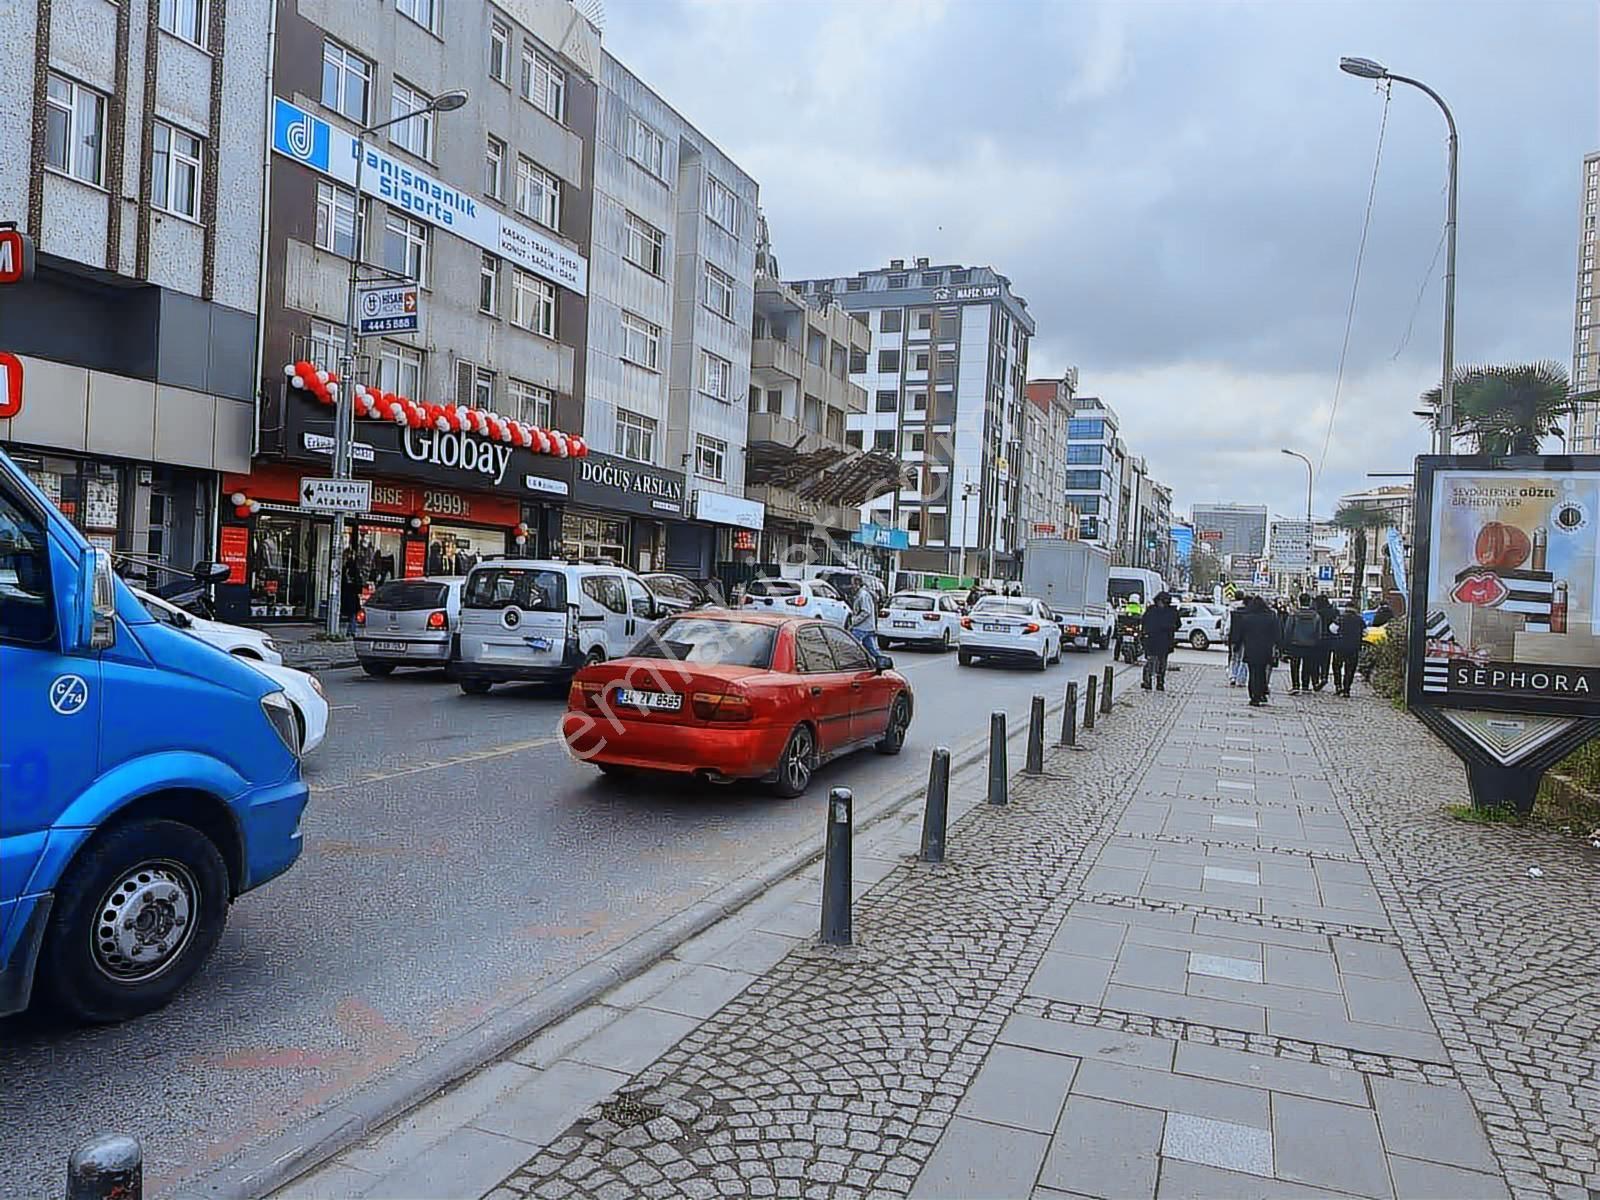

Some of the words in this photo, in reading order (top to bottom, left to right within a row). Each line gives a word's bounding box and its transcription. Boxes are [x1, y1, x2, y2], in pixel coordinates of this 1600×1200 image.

[380, 176, 453, 225] Sigorta
[503, 226, 526, 245] KASKO
[502, 241, 526, 258] KONUT
[403, 424, 512, 485] Globay
[581, 461, 630, 493] DOĞUŞ
[633, 475, 682, 500] ARSLAN
[316, 497, 361, 508] Atakent
[1519, 486, 1556, 498] GÜZEL
[1458, 668, 1589, 693] SEPHORA
